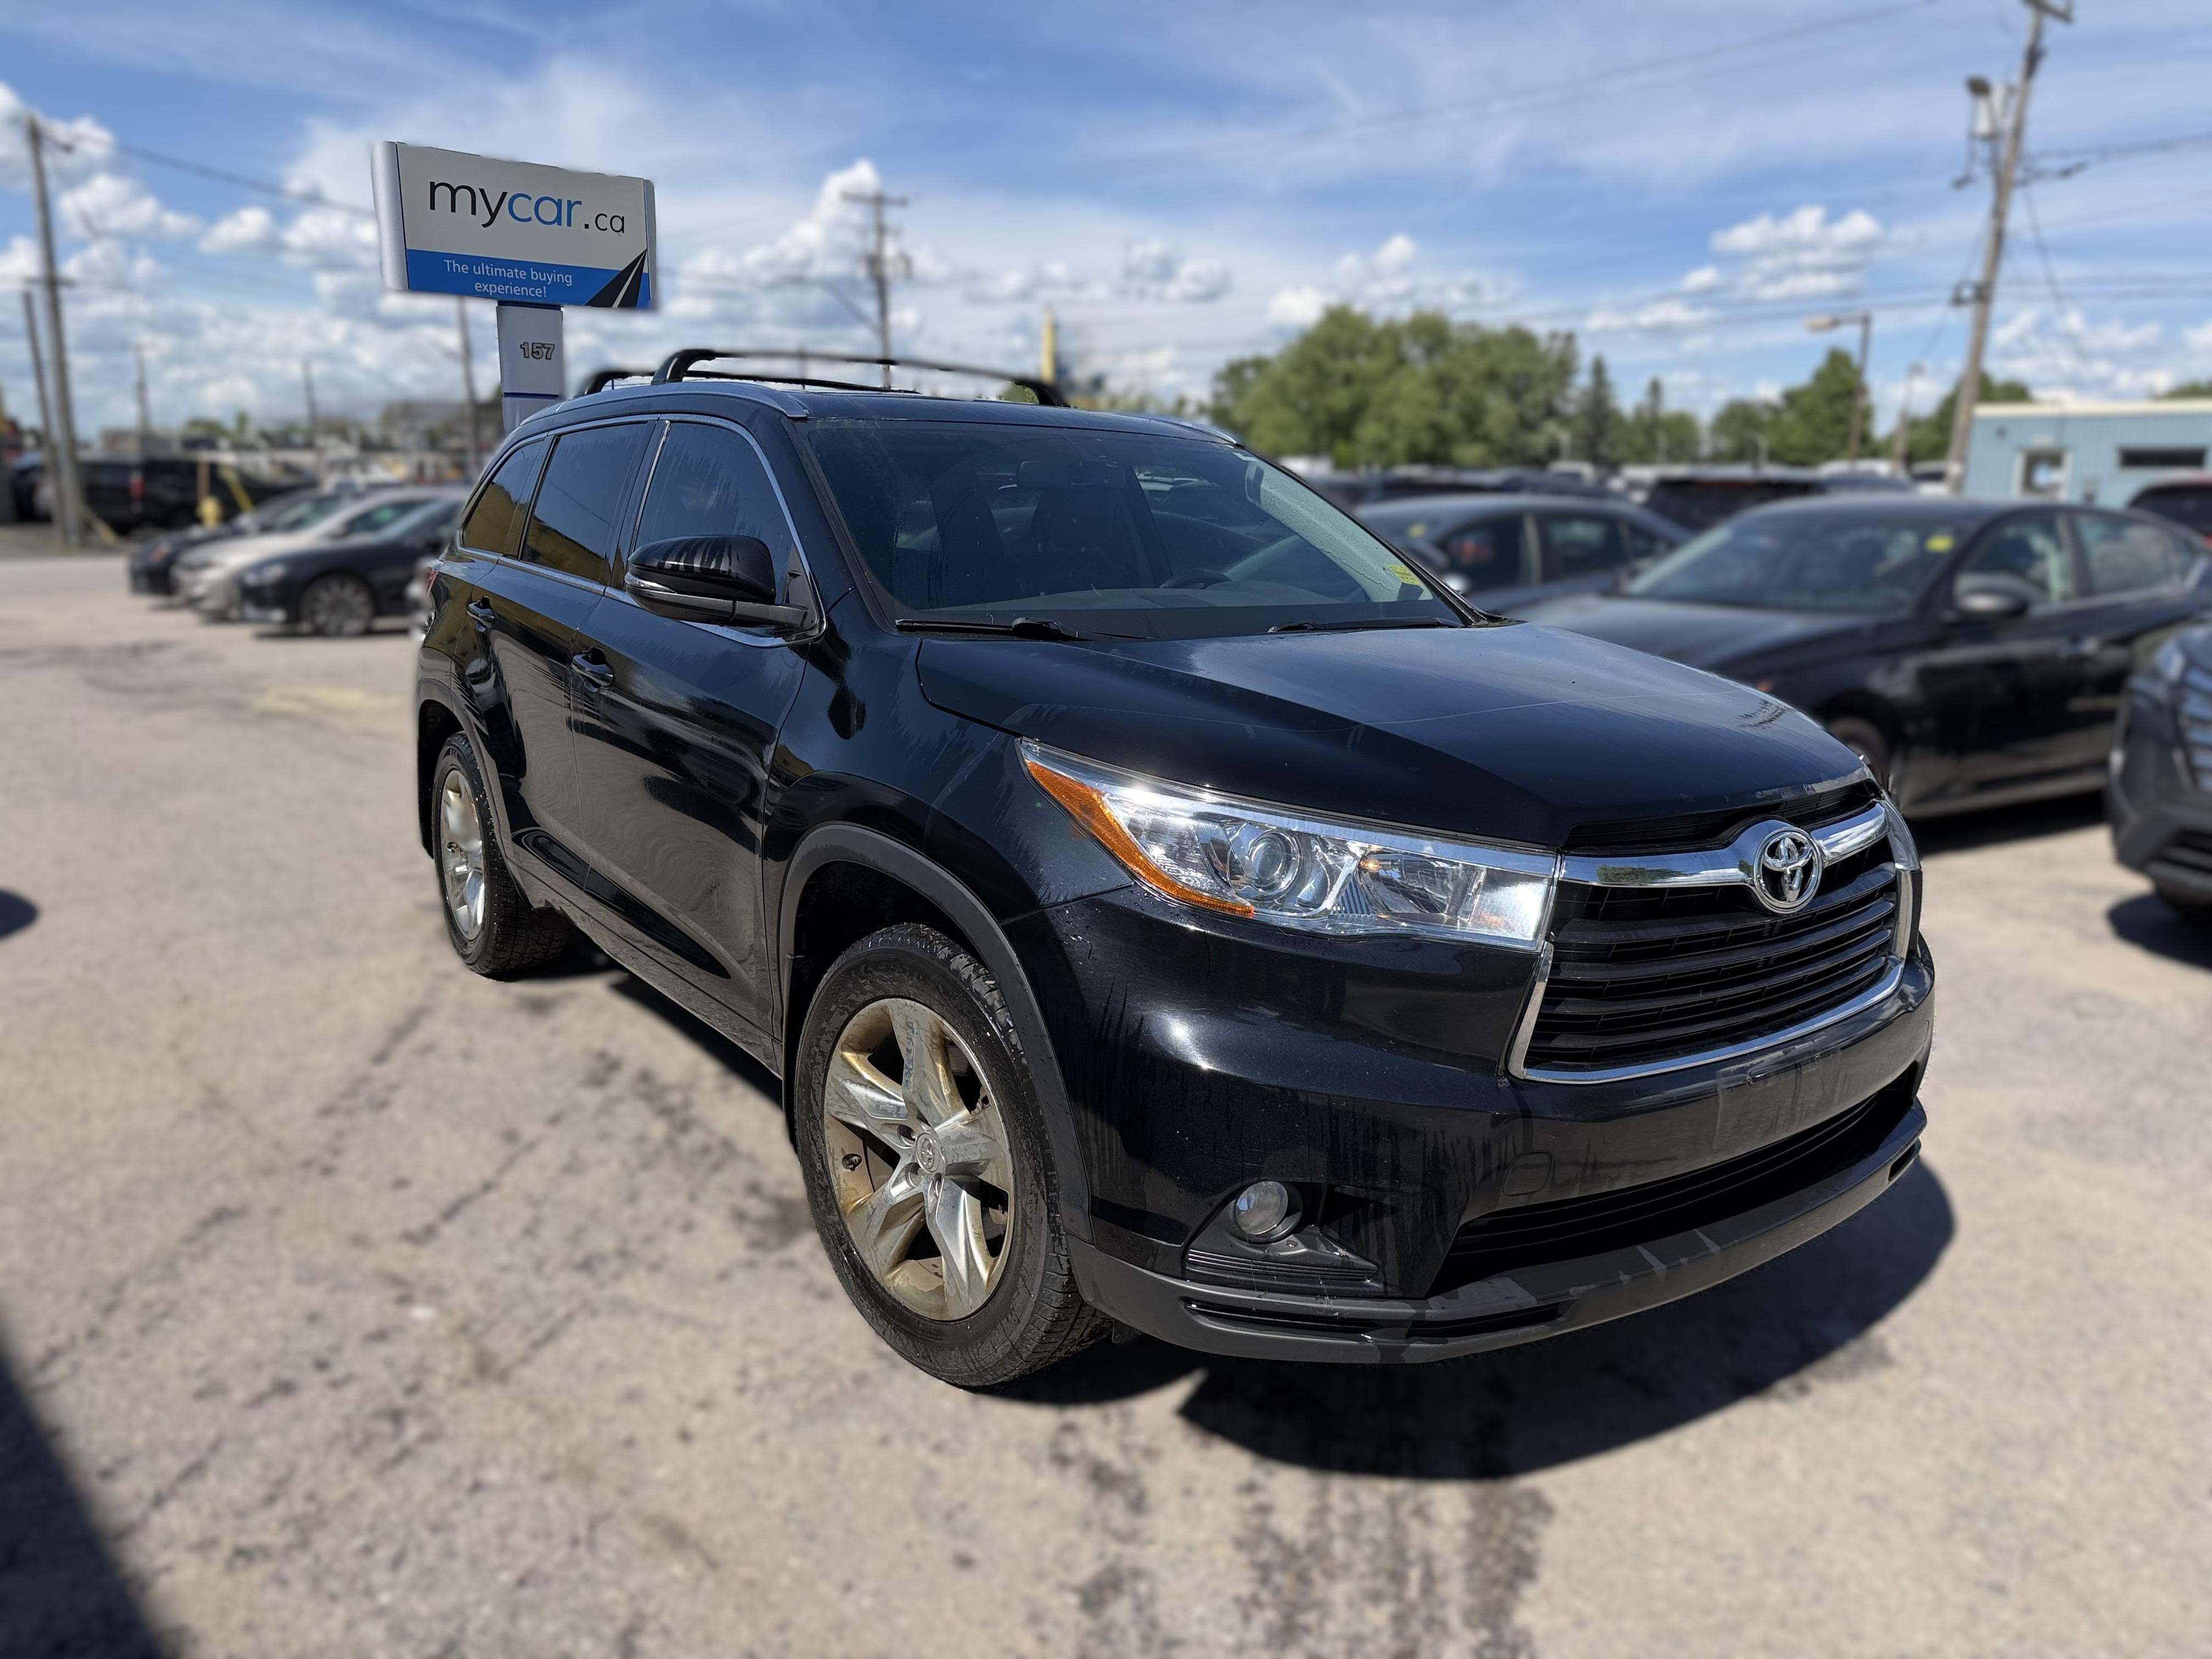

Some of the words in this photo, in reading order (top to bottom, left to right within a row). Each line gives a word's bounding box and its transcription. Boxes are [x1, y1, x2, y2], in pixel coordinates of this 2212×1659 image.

[429, 181, 625, 233] mycar.ca
[444, 260, 469, 274] The
[473, 263, 527, 280] ultimate
[531, 270, 572, 286] buying
[475, 282, 547, 297] experience!
[520, 342, 555, 359] 157
